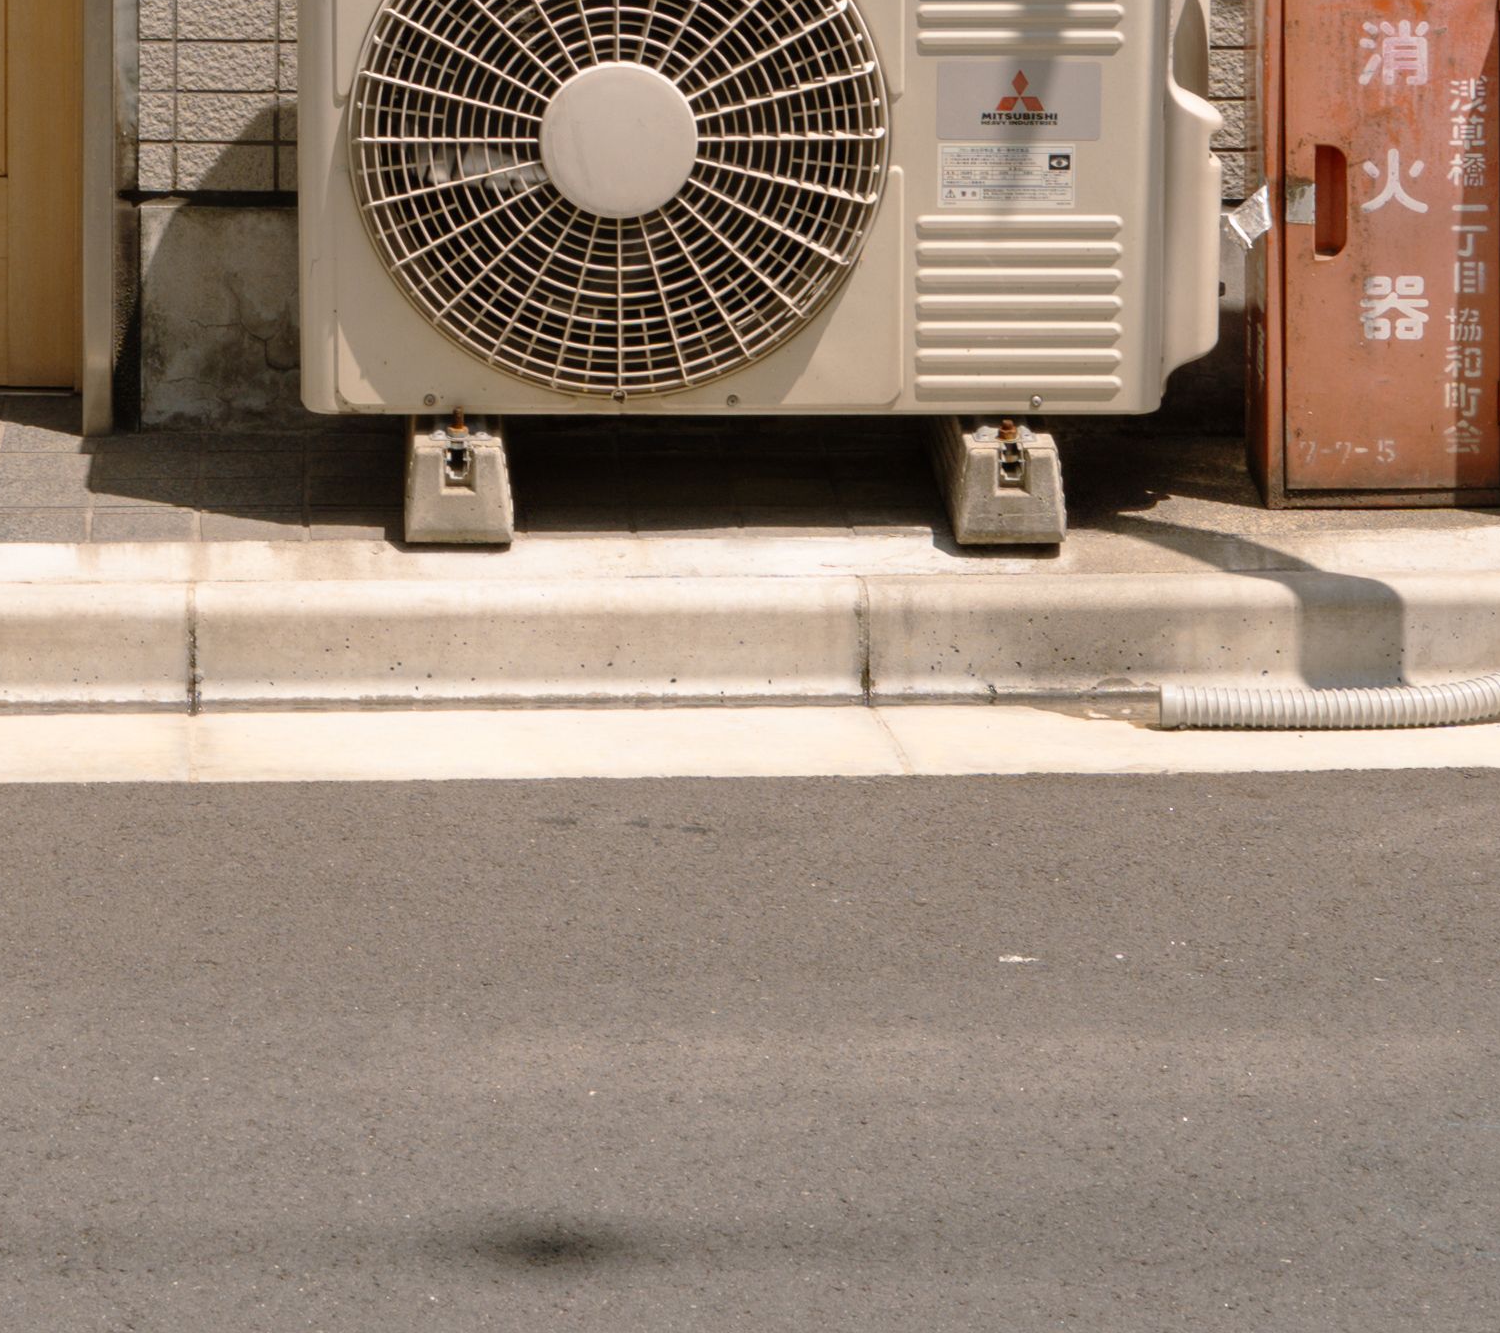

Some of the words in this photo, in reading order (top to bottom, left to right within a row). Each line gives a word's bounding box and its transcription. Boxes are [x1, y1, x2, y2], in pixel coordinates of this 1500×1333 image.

[981, 112, 1058, 120] MITSUBISHI
[1358, 19, 1430, 340] 消火器
